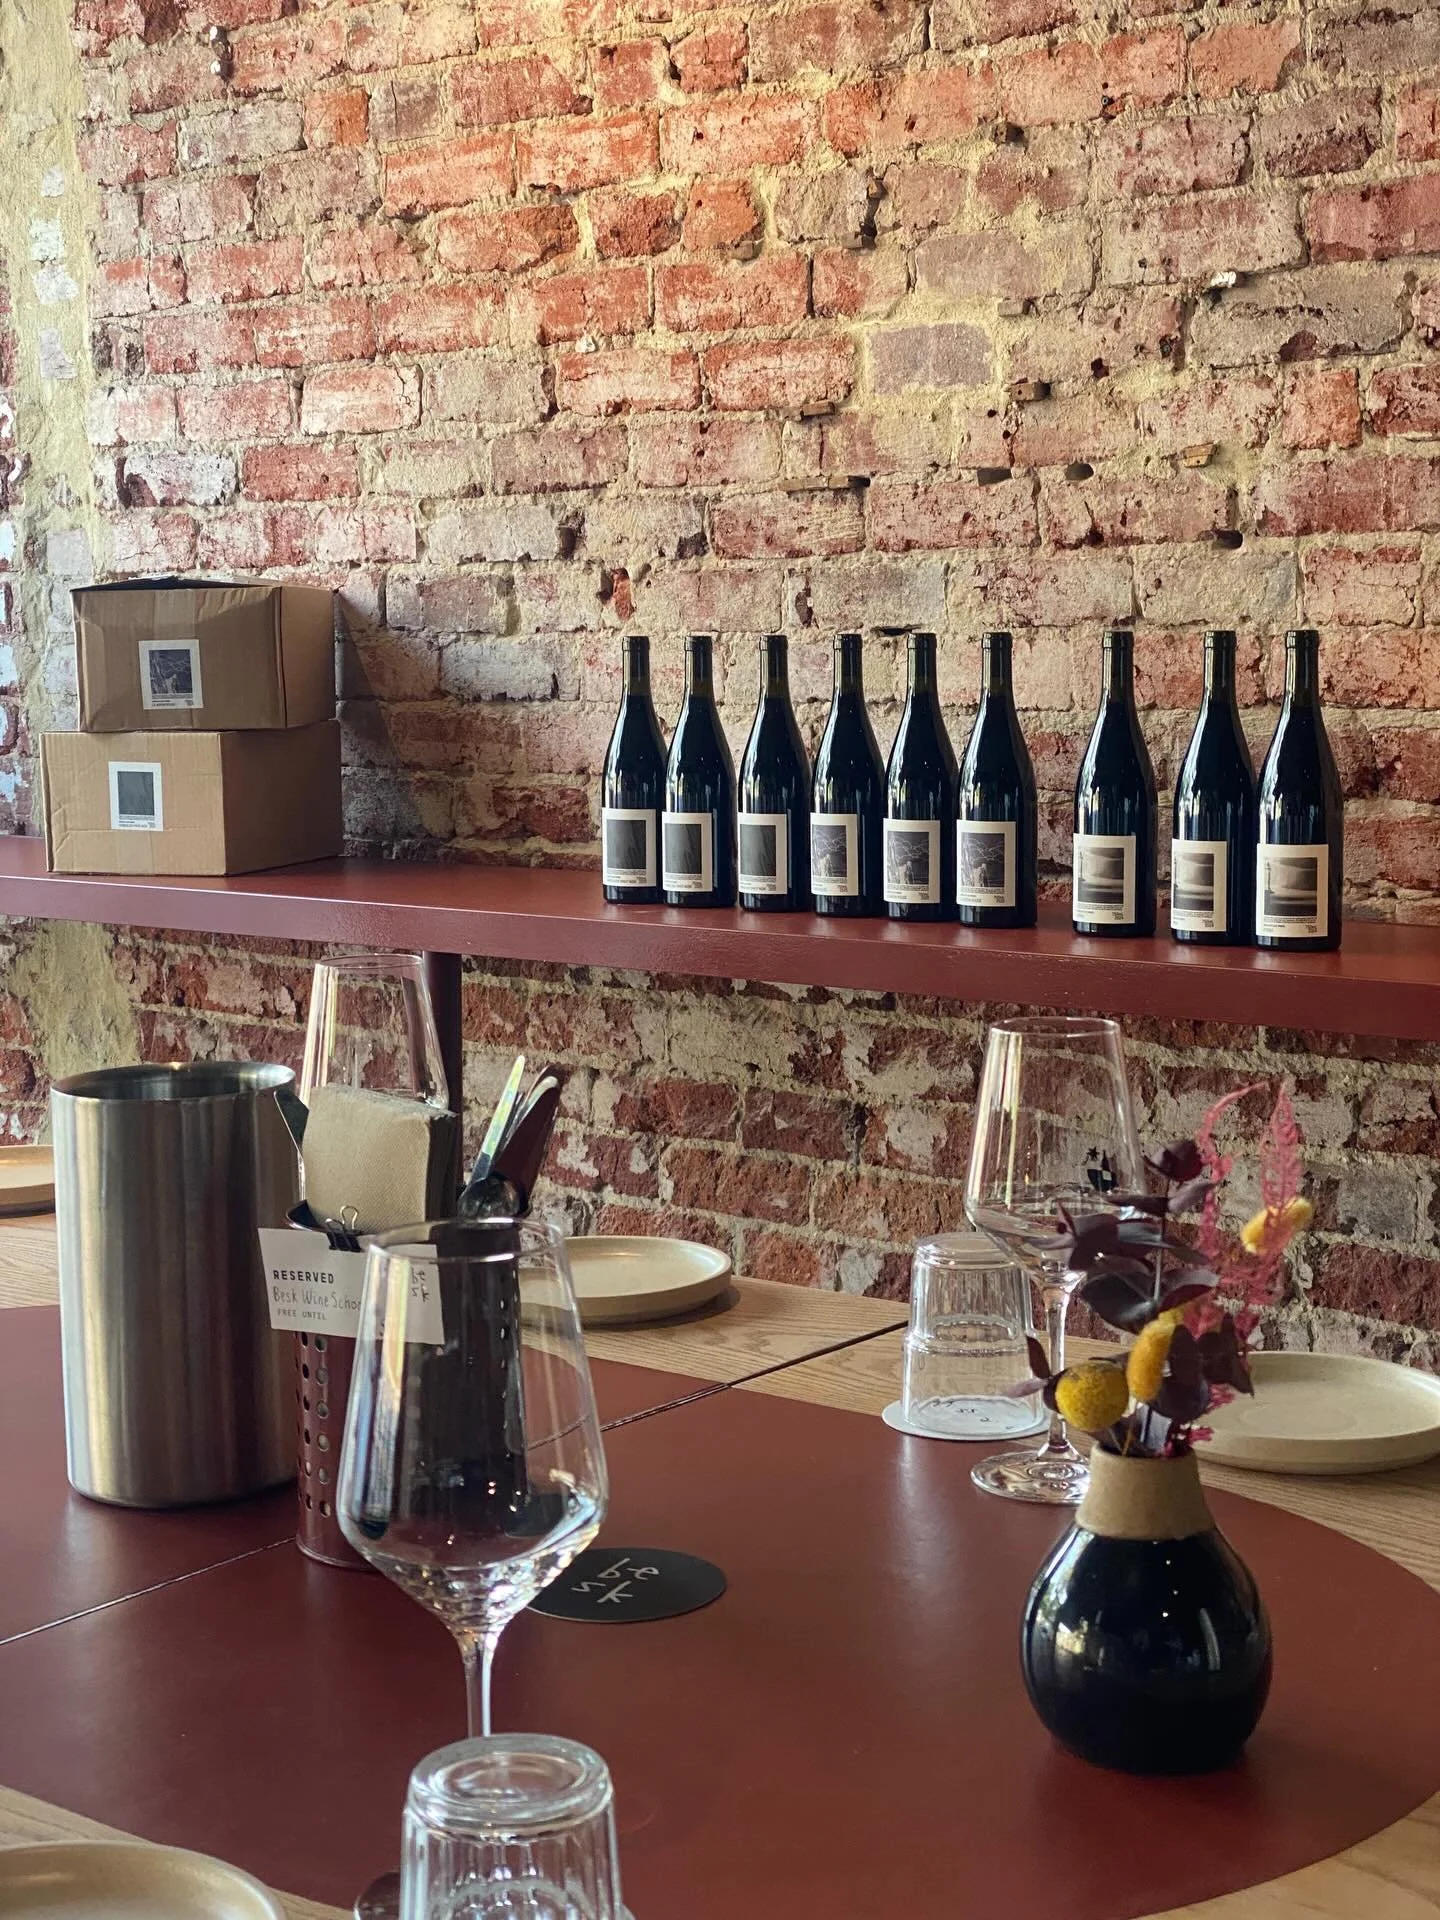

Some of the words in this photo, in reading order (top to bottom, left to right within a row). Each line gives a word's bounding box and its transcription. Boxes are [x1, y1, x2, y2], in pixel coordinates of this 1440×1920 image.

[272, 1269, 335, 1285] RESERVED
[272, 1287, 298, 1305] Besk
[301, 1289, 330, 1308] Wine
[277, 1308, 298, 1319] FREE
[301, 1311, 328, 1321] UNTIL
